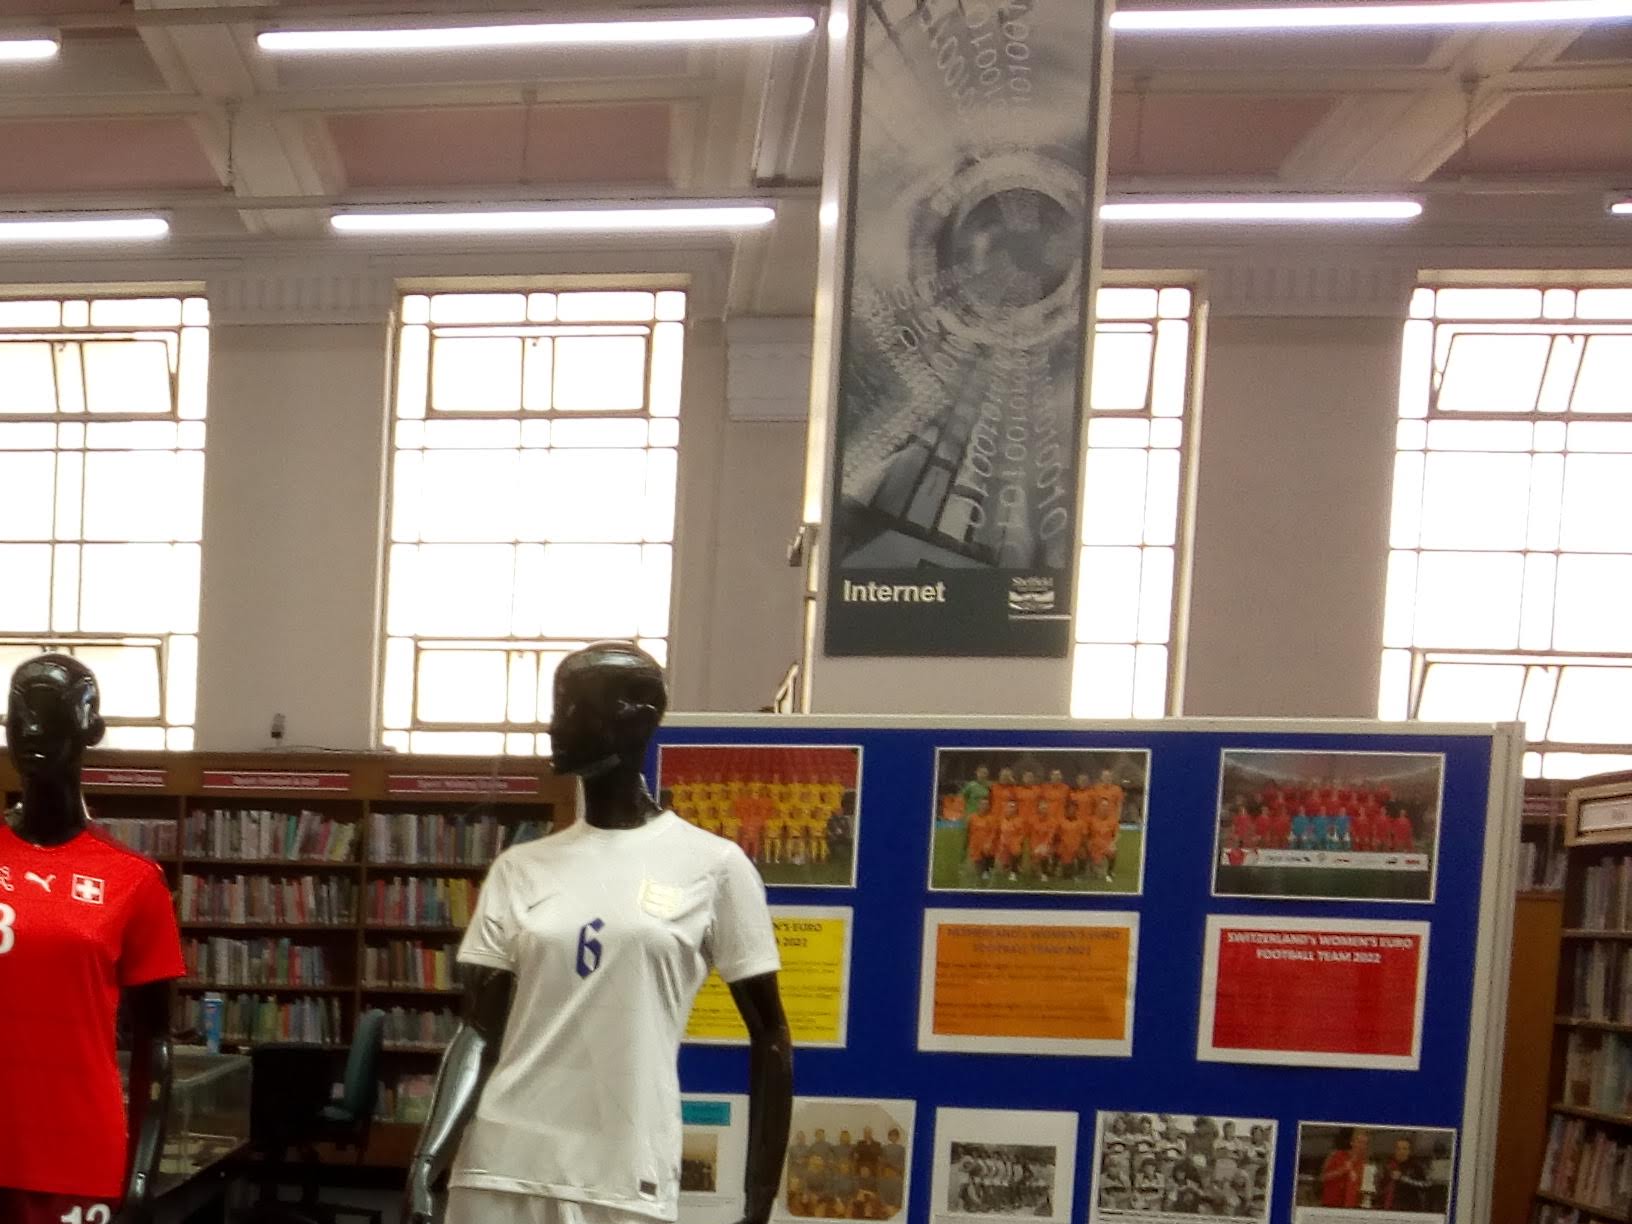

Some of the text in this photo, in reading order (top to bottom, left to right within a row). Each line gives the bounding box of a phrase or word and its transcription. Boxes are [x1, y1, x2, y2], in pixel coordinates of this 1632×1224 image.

[843, 580, 946, 602] Internet
[576, 918, 605, 979] 6
[1379, 935, 1413, 950] EURO
[1256, 948, 1314, 962] FOOTBALL
[1318, 949, 1351, 963] TEAM
